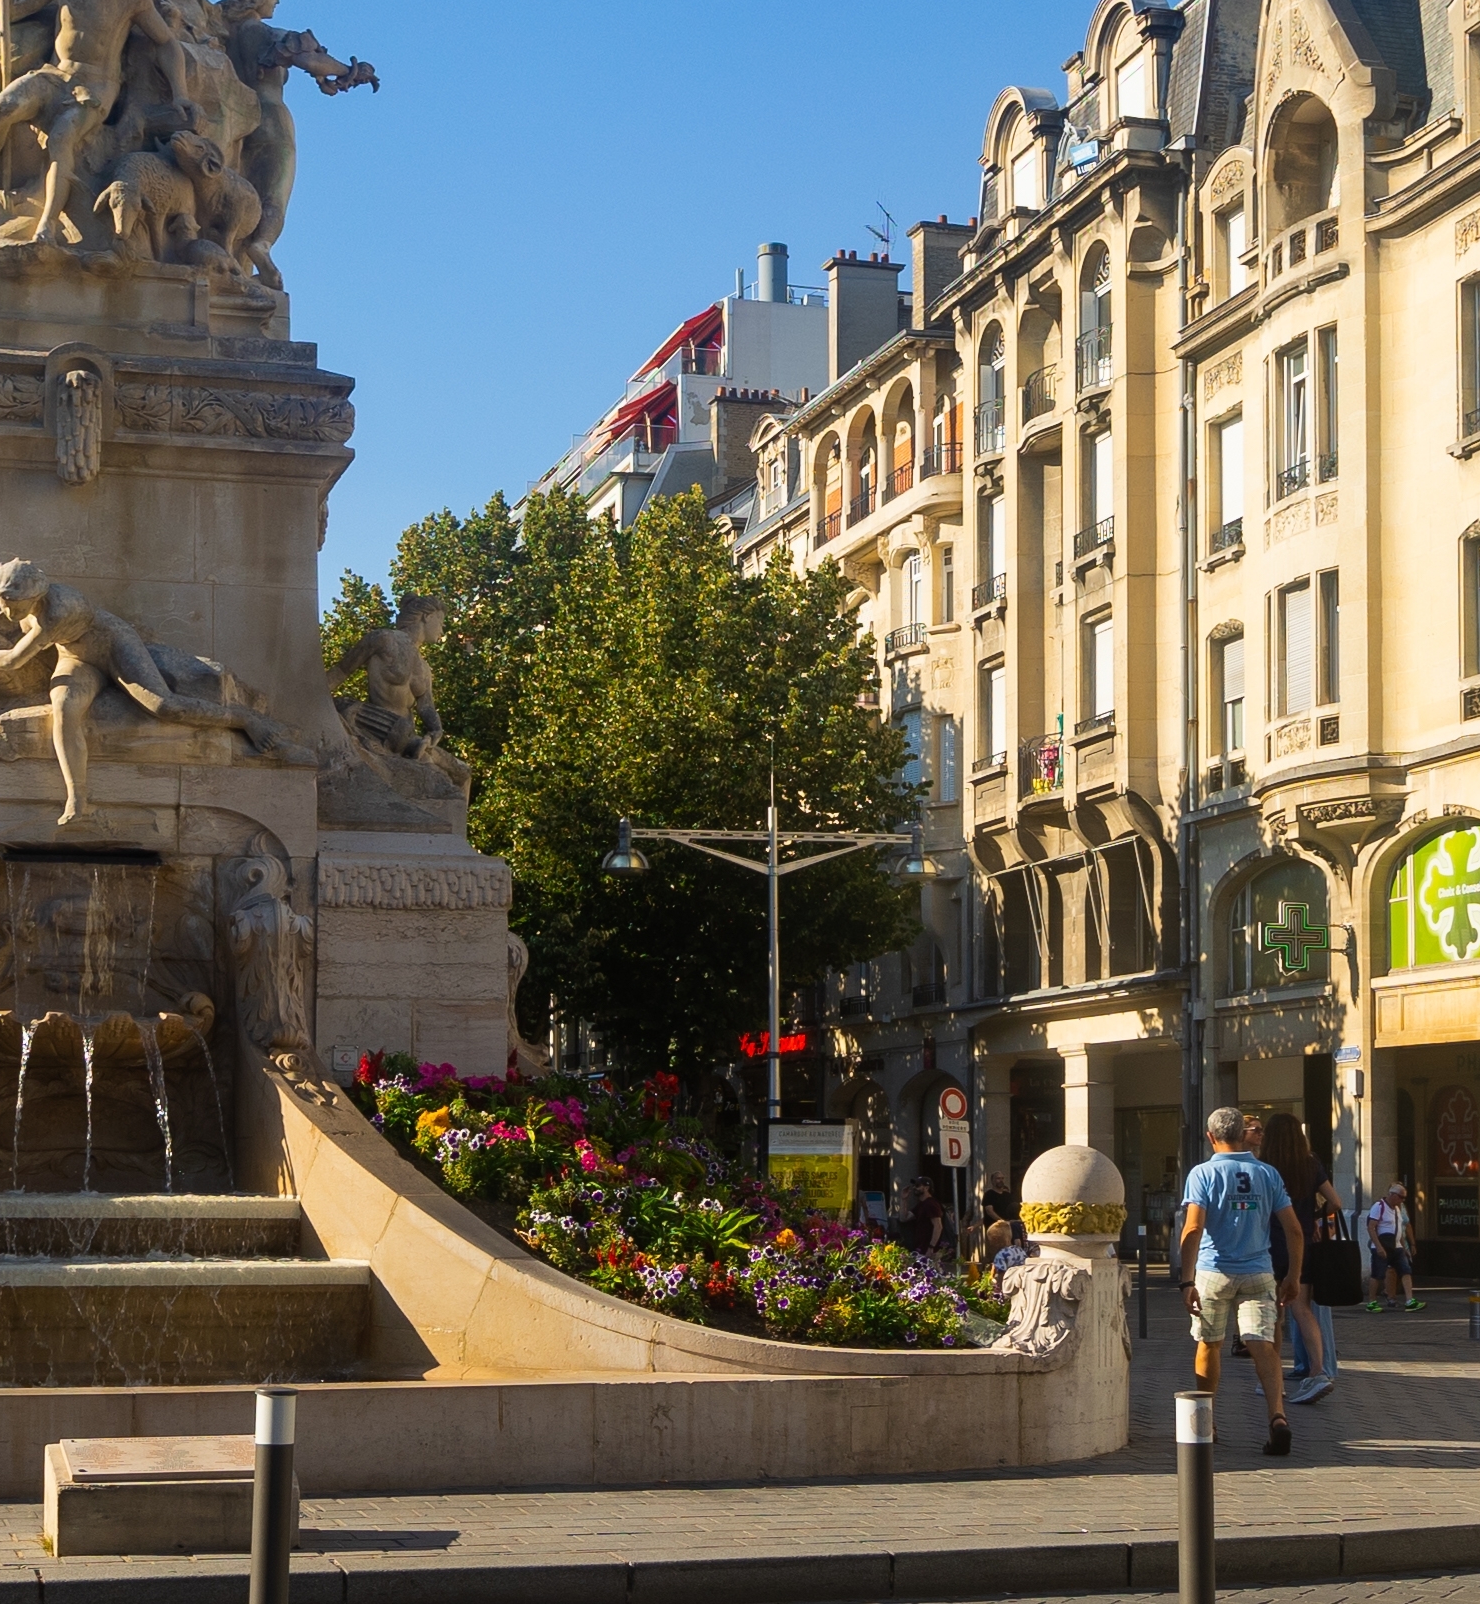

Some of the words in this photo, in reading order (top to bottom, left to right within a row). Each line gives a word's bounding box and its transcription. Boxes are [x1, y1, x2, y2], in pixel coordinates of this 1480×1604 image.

[1438, 886, 1455, 899] Choix
[1455, 884, 1462, 896] &
[948, 1137, 962, 1159] D
[1235, 1171, 1251, 1193] 3
